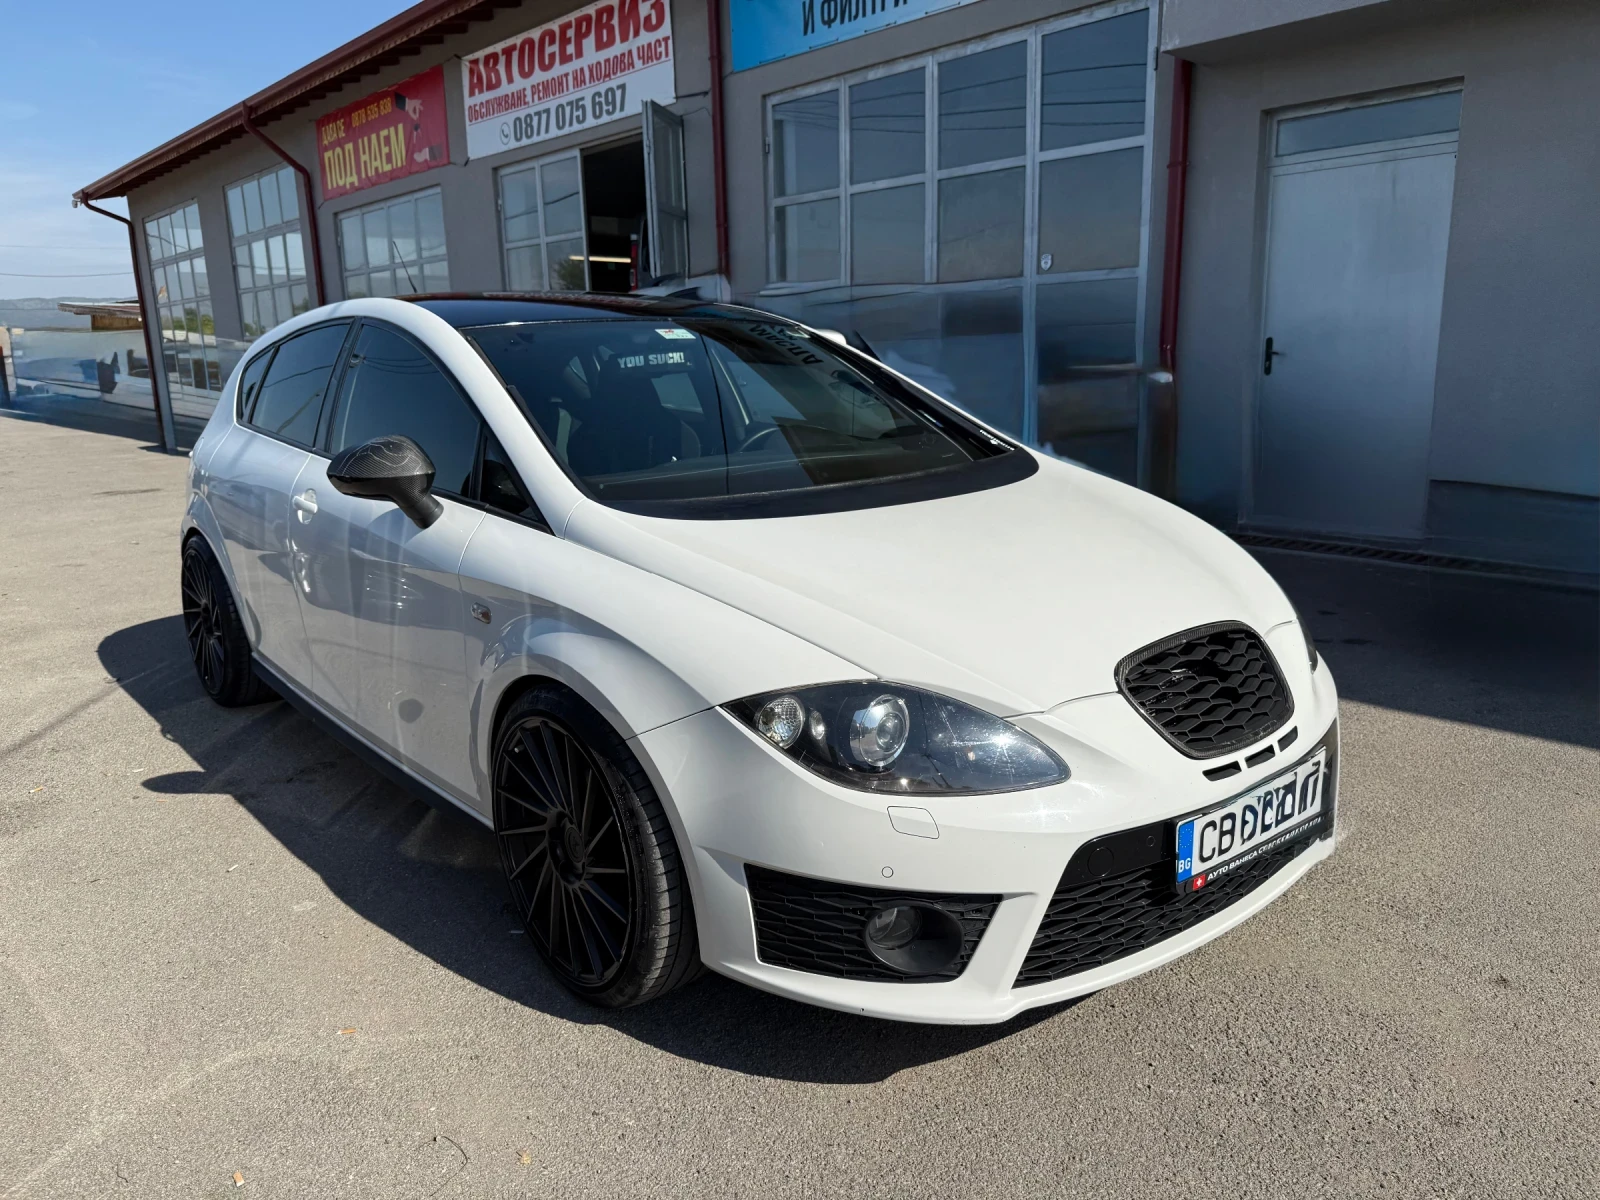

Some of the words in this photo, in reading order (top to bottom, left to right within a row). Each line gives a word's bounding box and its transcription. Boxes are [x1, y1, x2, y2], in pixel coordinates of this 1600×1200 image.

[820, 0, 907, 28] ФИЛ
[468, 0, 666, 98] АВТОСЕРВИЗ
[468, 89, 530, 122] ОБСЛУЖВАНЕ,
[530, 73, 570, 104] РЕМОНТ
[572, 69, 587, 91] НА
[588, 50, 635, 84] ХОДОВА
[637, 36, 671, 64] ЧАСТ
[513, 106, 551, 143] 0877
[555, 96, 587, 131] 075
[591, 83, 627, 120] 697
[324, 141, 359, 190] ПОД
[358, 123, 406, 179] НАЕМ
[617, 355, 645, 369] YOU
[648, 351, 685, 365] SUCK!
[1178, 858, 1191, 874] BG
